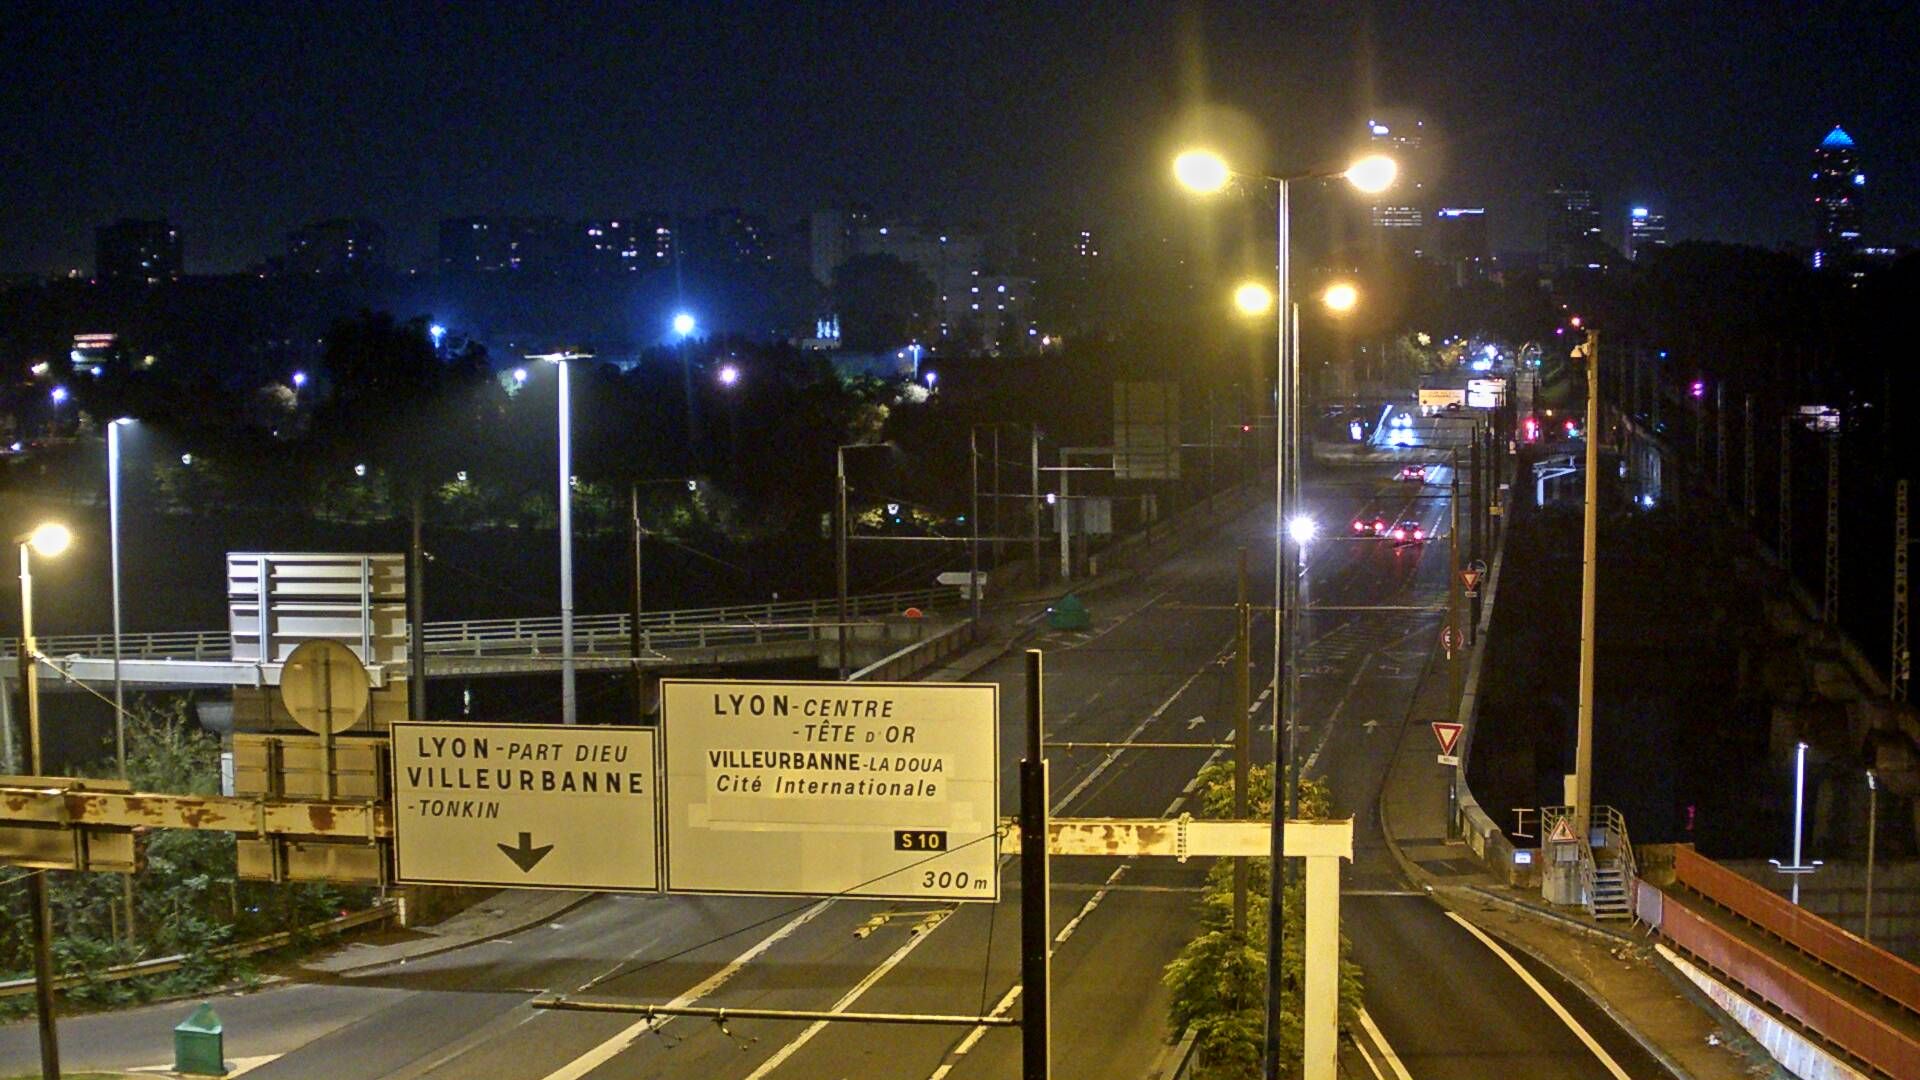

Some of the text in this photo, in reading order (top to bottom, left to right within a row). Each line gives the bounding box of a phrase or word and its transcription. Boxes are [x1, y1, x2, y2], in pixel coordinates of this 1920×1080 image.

[576, 745, 627, 762] DIEU
[895, 758, 942, 772] DOUA
[408, 767, 642, 793] VILLEURBANNE
[717, 775, 936, 796] Cité Internationale
[902, 833, 940, 849] S 10
[922, 870, 988, 890] 300 m
